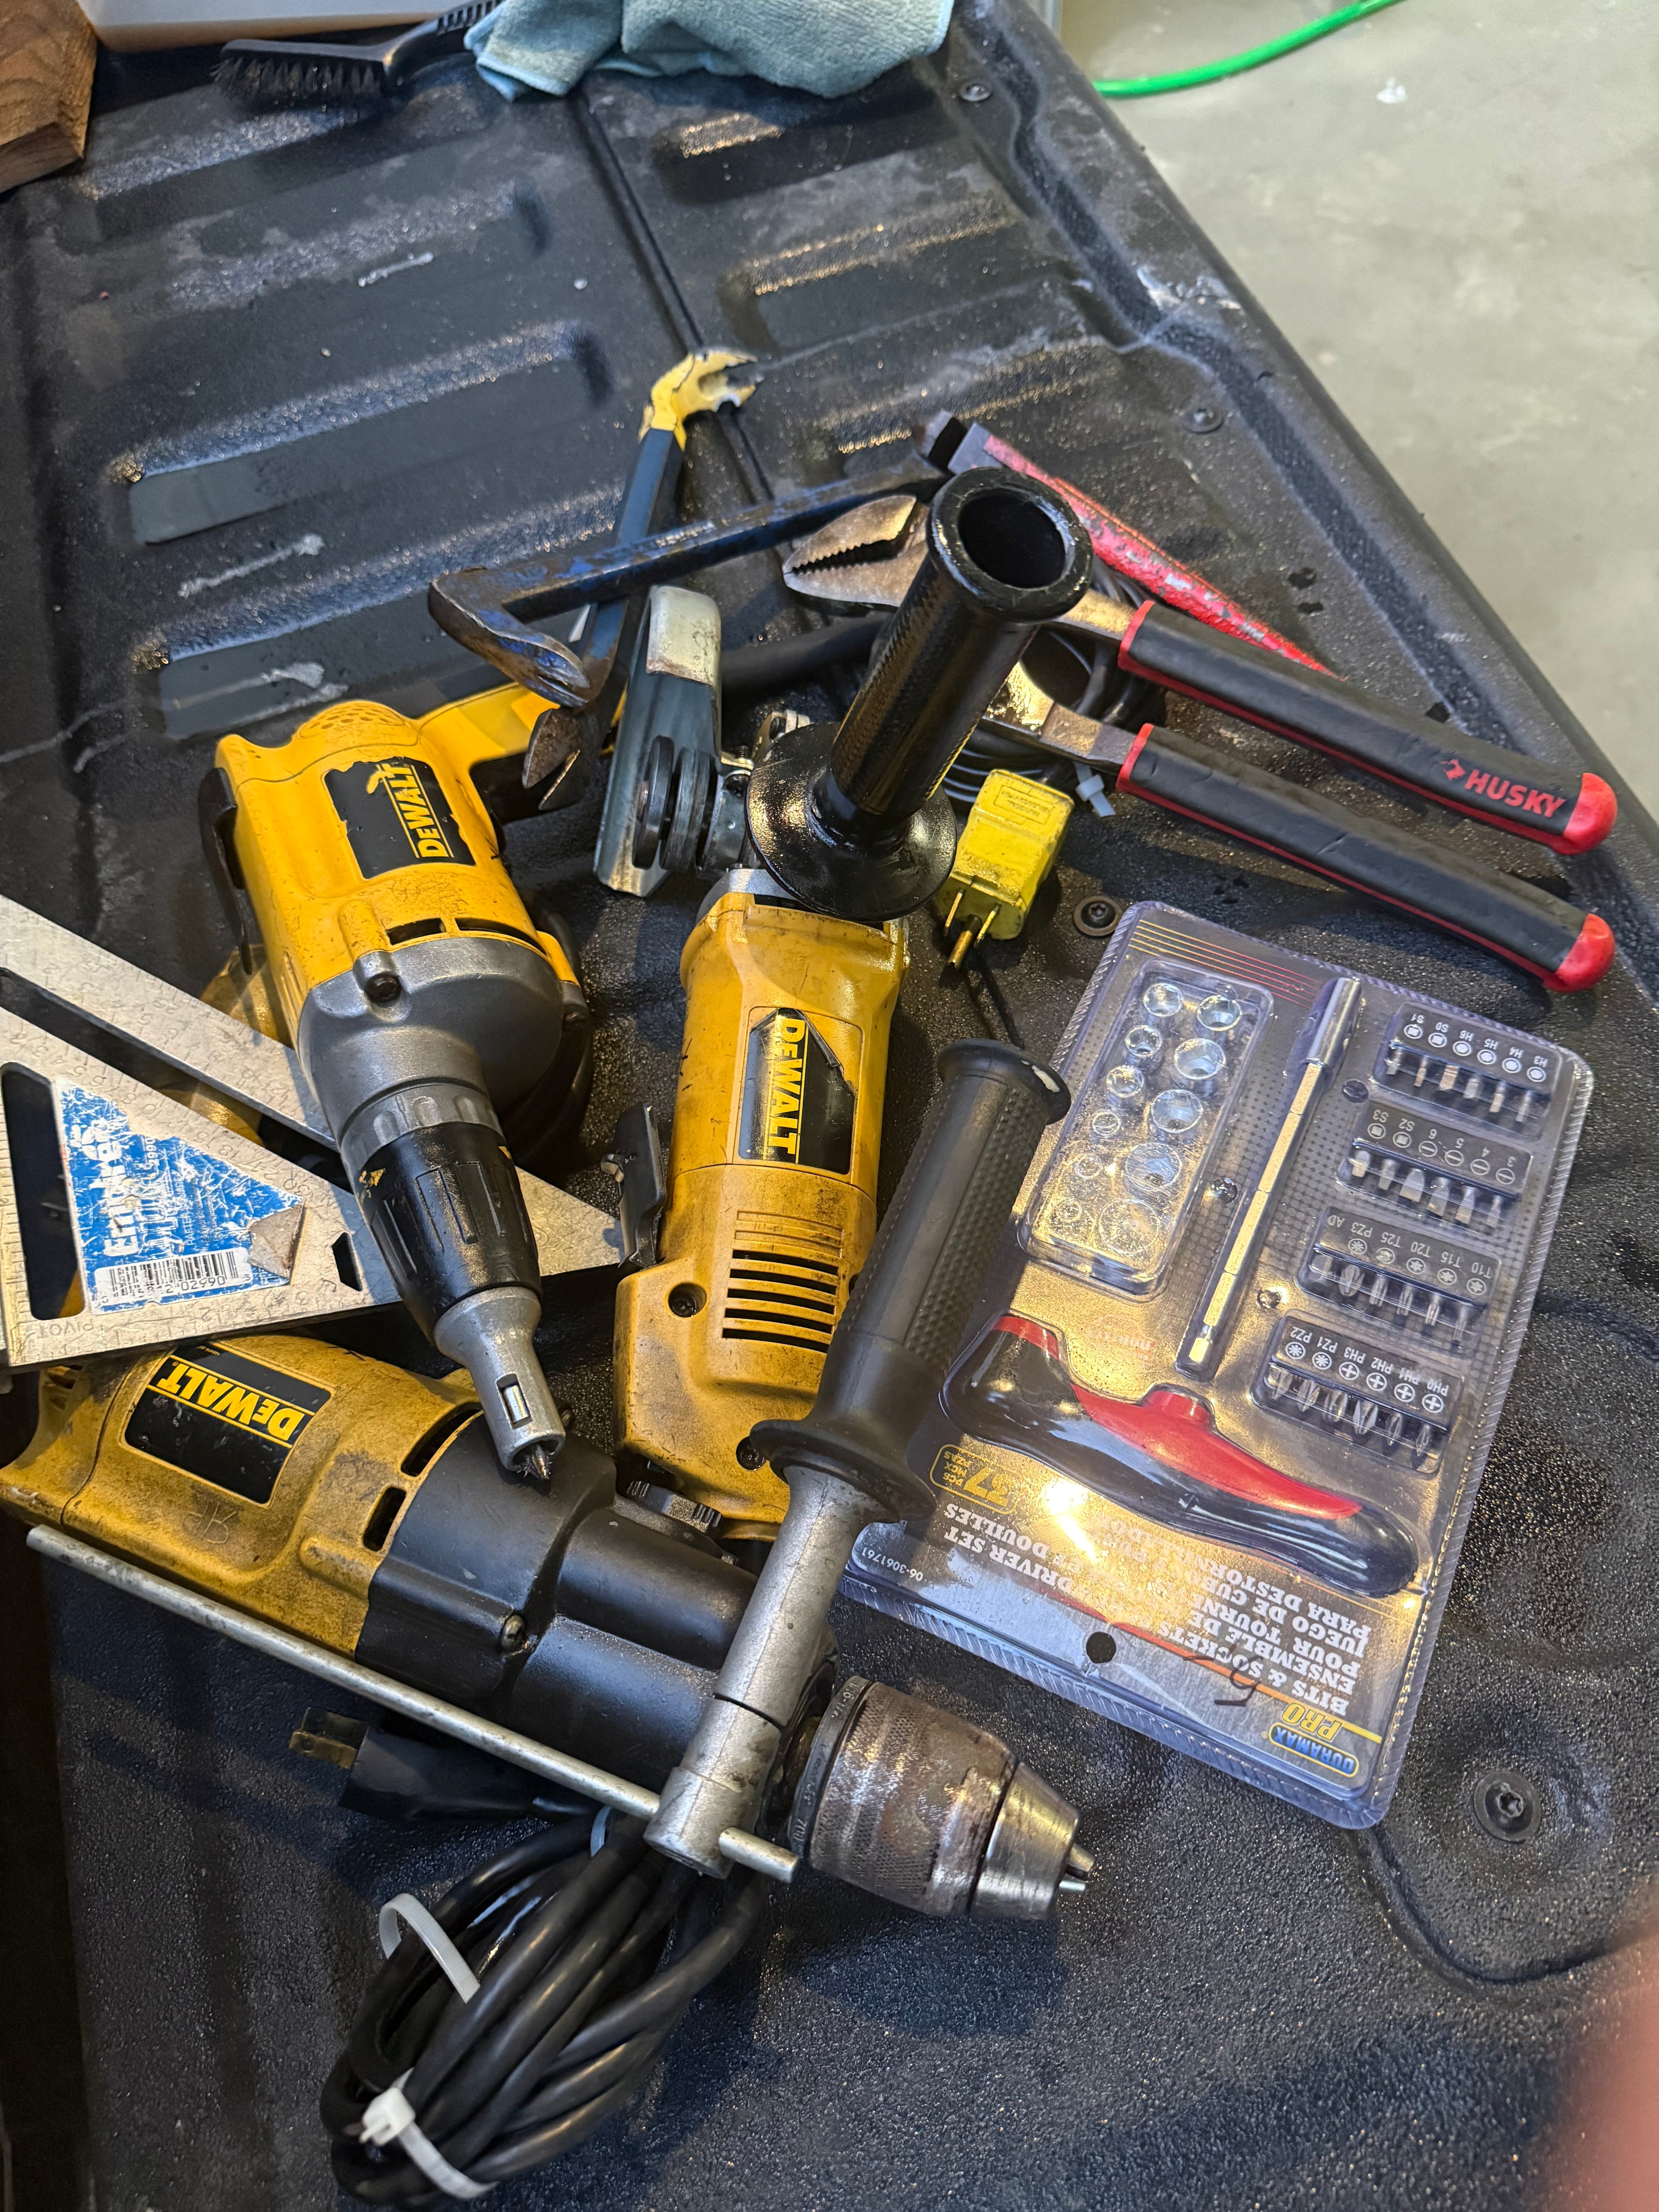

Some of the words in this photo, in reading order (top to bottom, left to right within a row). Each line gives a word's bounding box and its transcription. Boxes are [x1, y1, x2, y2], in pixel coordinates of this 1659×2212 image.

[1465, 767, 1565, 818] HUSKY
[1411, 1013, 1424, 1024] S1
[1459, 1030, 1473, 1042] H6
[1484, 1039, 1498, 1049] H5
[1509, 1047, 1524, 1058] H4
[1534, 1055, 1548, 1067] H3
[768, 1017, 806, 1155] DEWALT
[1373, 1109, 1388, 1122] S3
[1399, 1118, 1414, 1131] S2
[1429, 1129, 1437, 1139] 6
[1456, 1138, 1464, 1148] 5
[1482, 1147, 1490, 1157] 4
[1507, 1156, 1516, 1166] 3
[1327, 1214, 1345, 1228] AD
[1351, 1222, 1373, 1238] PZ3
[1380, 1232, 1401, 1248] T25
[1411, 1241, 1431, 1257] T20
[1440, 1251, 1461, 1268] T15
[1471, 1262, 1492, 1278] T10
[180, 1275, 226, 1291] 02990
[1291, 1326, 1313, 1344] PZ2
[1316, 1336, 1339, 1354] PZ1
[1343, 1347, 1366, 1364] PH3
[1370, 1357, 1394, 1374] PH2
[157, 1361, 305, 1441] DEWALT
[943, 1462, 967, 1477] MCX
[941, 1471, 963, 1486] PCS
[963, 1467, 1015, 1506] 37
[944, 1503, 1048, 1558] DOUILLES
[944, 1525, 986, 1553] SET
[861, 1548, 923, 1582] 06-3061761
[1251, 1597, 1288, 1624] DE
[1186, 1609, 1222, 1635] DE
[1304, 1601, 1370, 1640] PARA
[1290, 1608, 1370, 1657] JUEGO
[1158, 1625, 1262, 1676] SOCKETS
[1290, 1637, 1361, 1678] POUR
[1225, 1626, 1355, 1694] ENSEMBLE
[1265, 1666, 1289, 1689] &
[1290, 1680, 1349, 1714] BITS
[1280, 1700, 1340, 1742] PRO
[1272, 1726, 1354, 1773] DURAMAX
